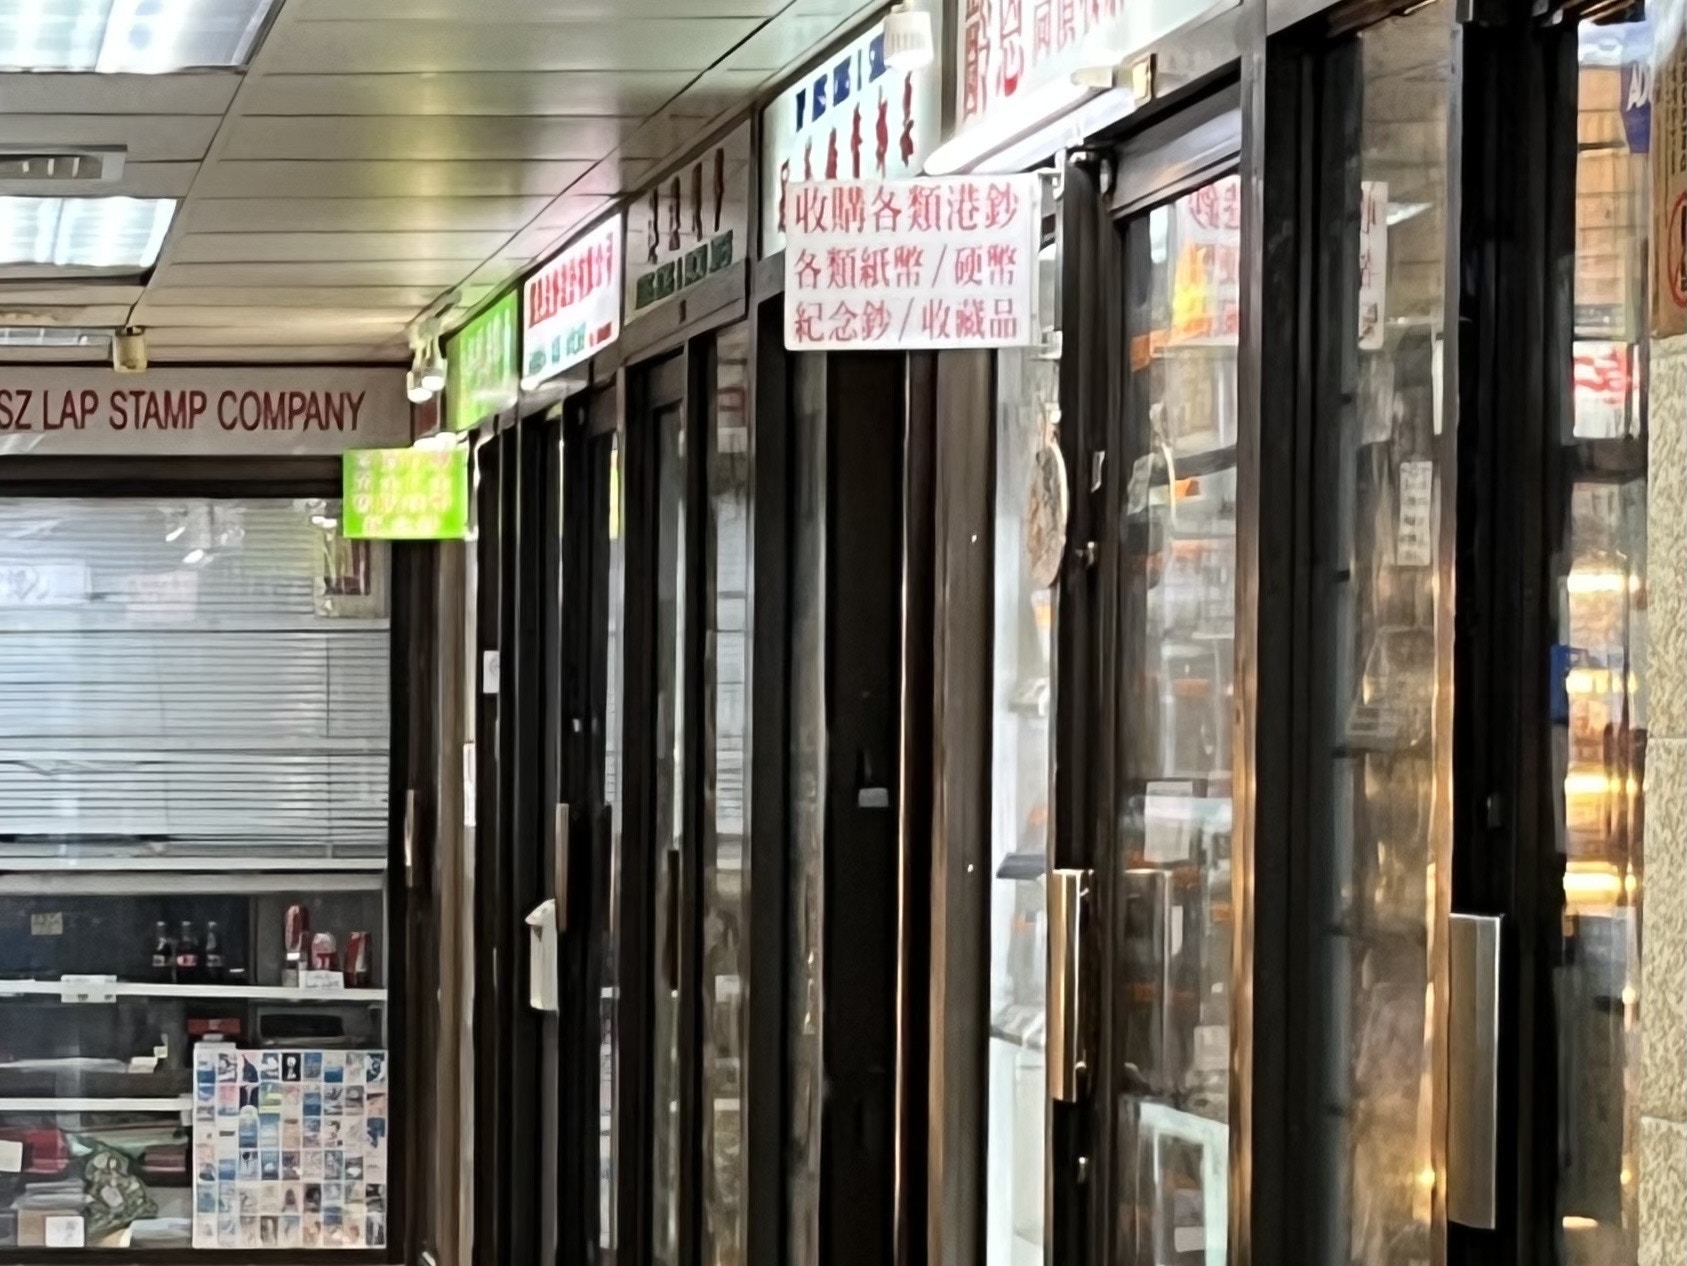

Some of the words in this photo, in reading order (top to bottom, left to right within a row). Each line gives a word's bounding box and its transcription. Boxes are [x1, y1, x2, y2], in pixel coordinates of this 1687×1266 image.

[795, 181, 1020, 234] 收購各類港鈔
[42, 388, 100, 431] LAP
[109, 388, 208, 431] STAMP
[217, 389, 366, 432] COMPANY
